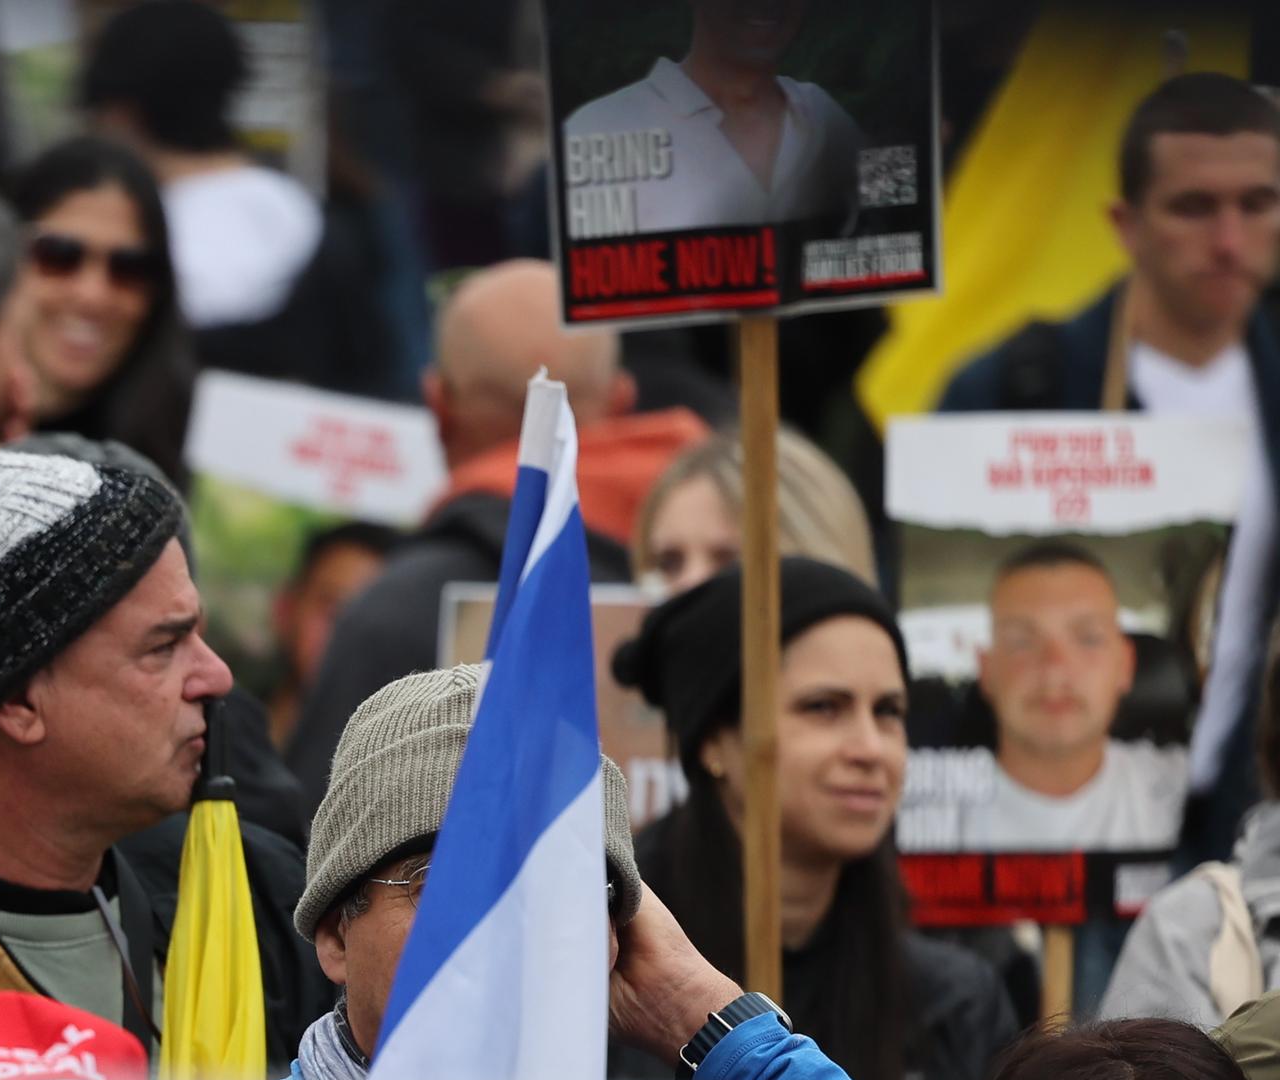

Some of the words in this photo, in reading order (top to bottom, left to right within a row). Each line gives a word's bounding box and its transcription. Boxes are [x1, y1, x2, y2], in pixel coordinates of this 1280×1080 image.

[569, 130, 671, 184] BRING
[570, 189, 636, 239] HIM
[571, 242, 668, 296] HOME
[677, 228, 775, 287] NOW!
